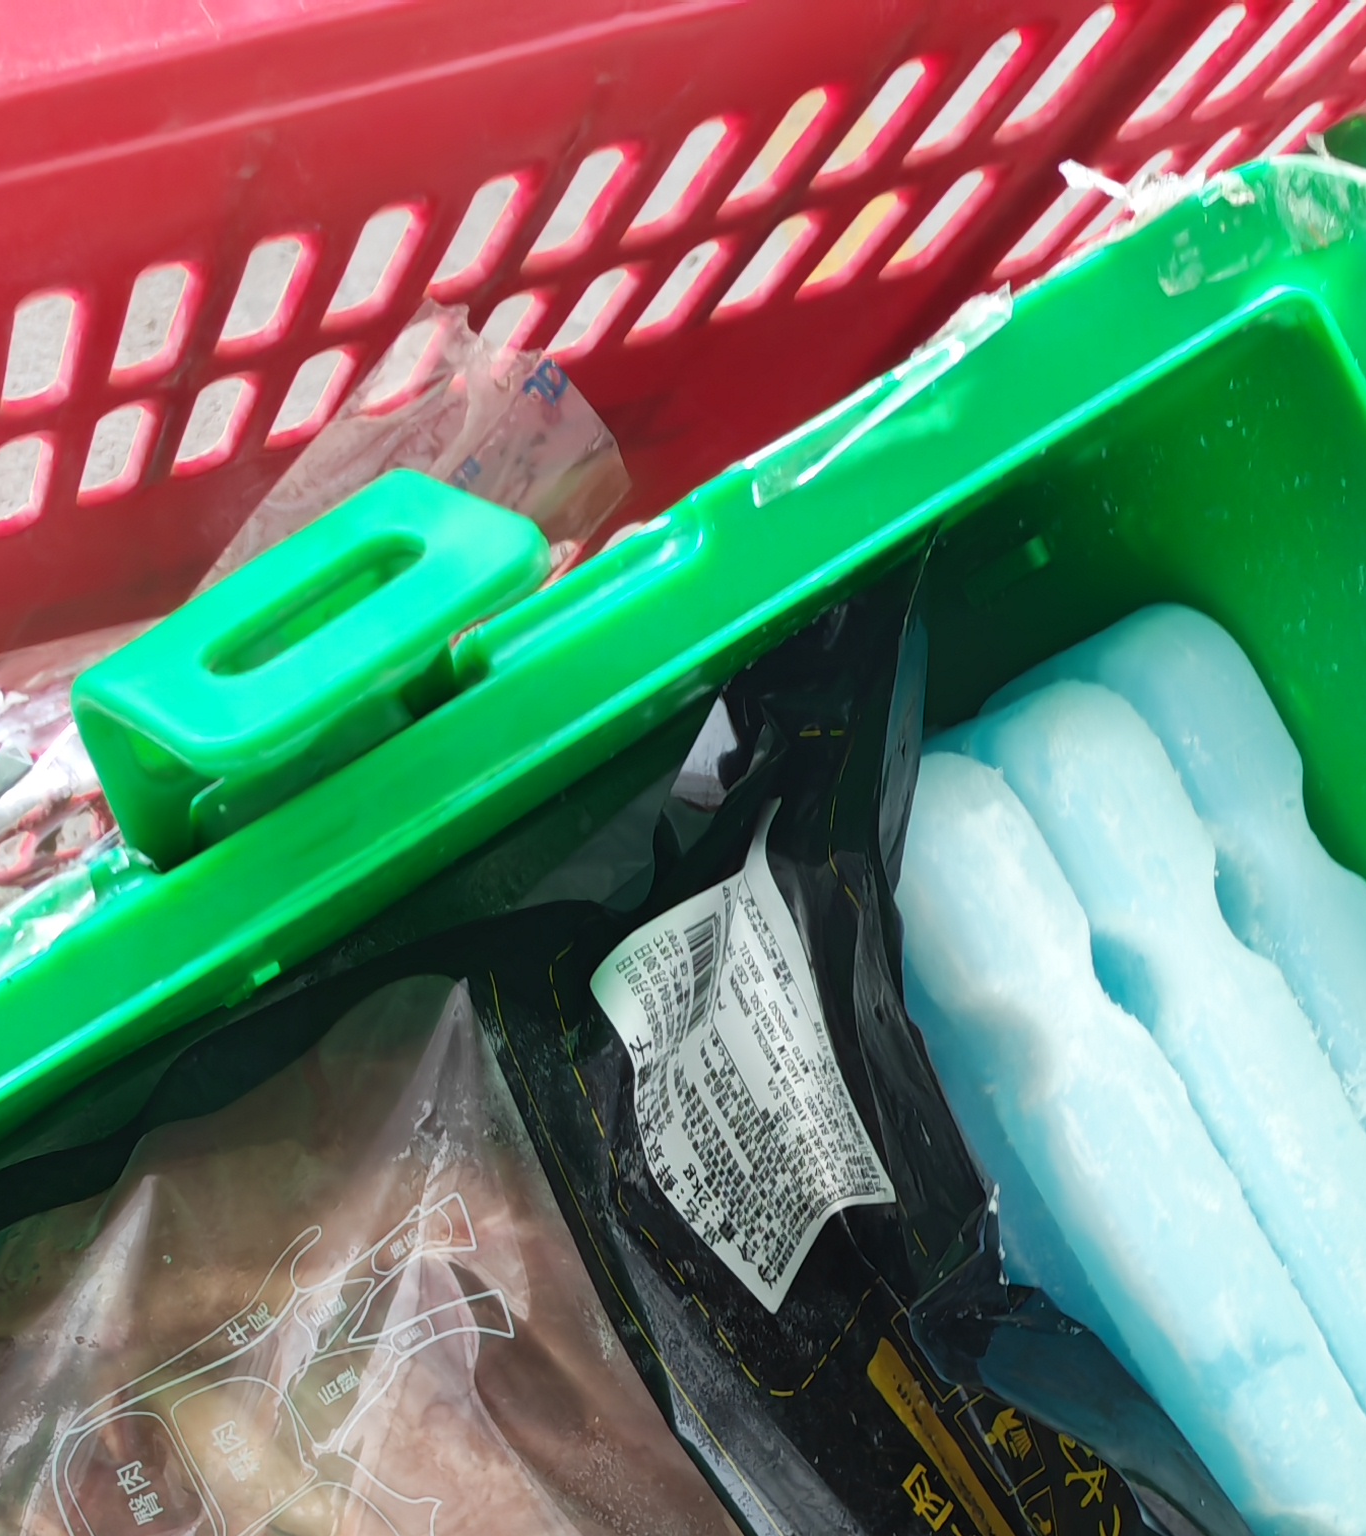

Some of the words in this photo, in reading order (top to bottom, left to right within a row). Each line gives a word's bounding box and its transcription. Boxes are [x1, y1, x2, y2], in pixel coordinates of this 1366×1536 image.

[221, 1301, 278, 1347] 牛尾
[212, 1420, 256, 1481] 霖肉
[116, 1460, 163, 1525] 臀肉
